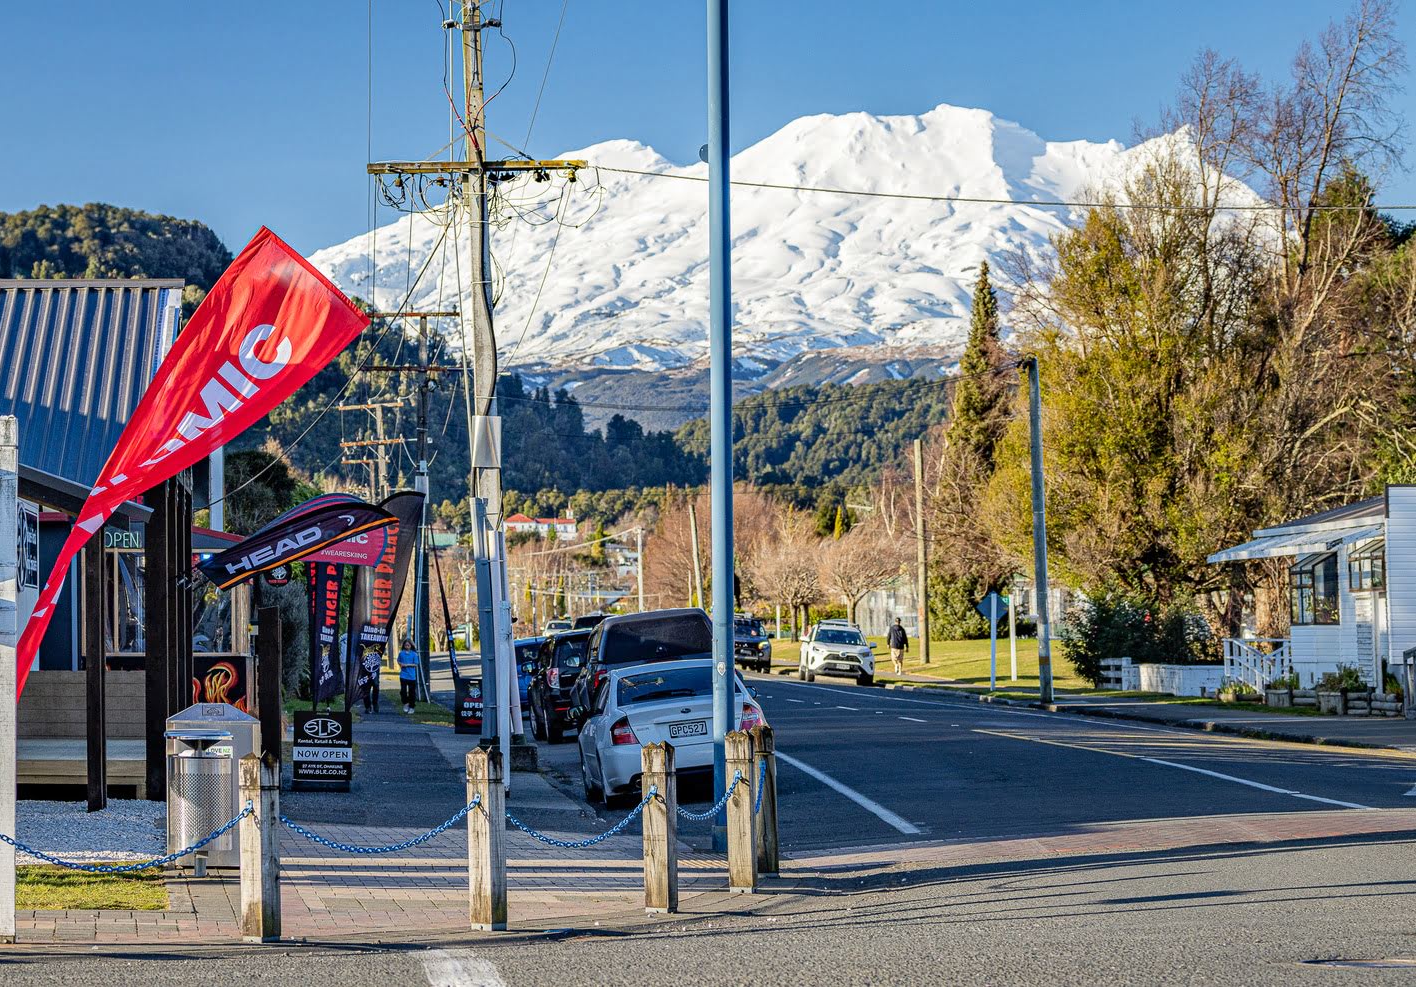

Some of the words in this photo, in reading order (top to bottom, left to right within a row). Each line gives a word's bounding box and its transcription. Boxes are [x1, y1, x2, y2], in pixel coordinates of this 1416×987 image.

[224, 526, 322, 575] HEAD
[375, 522, 400, 574] PALAC
[325, 580, 338, 627] TIGER
[370, 577, 393, 625] TIGER
[306, 719, 339, 737] SLR
[671, 723, 705, 736] GPC527
[297, 750, 319, 758] NOW
[322, 750, 348, 759] OPEN
